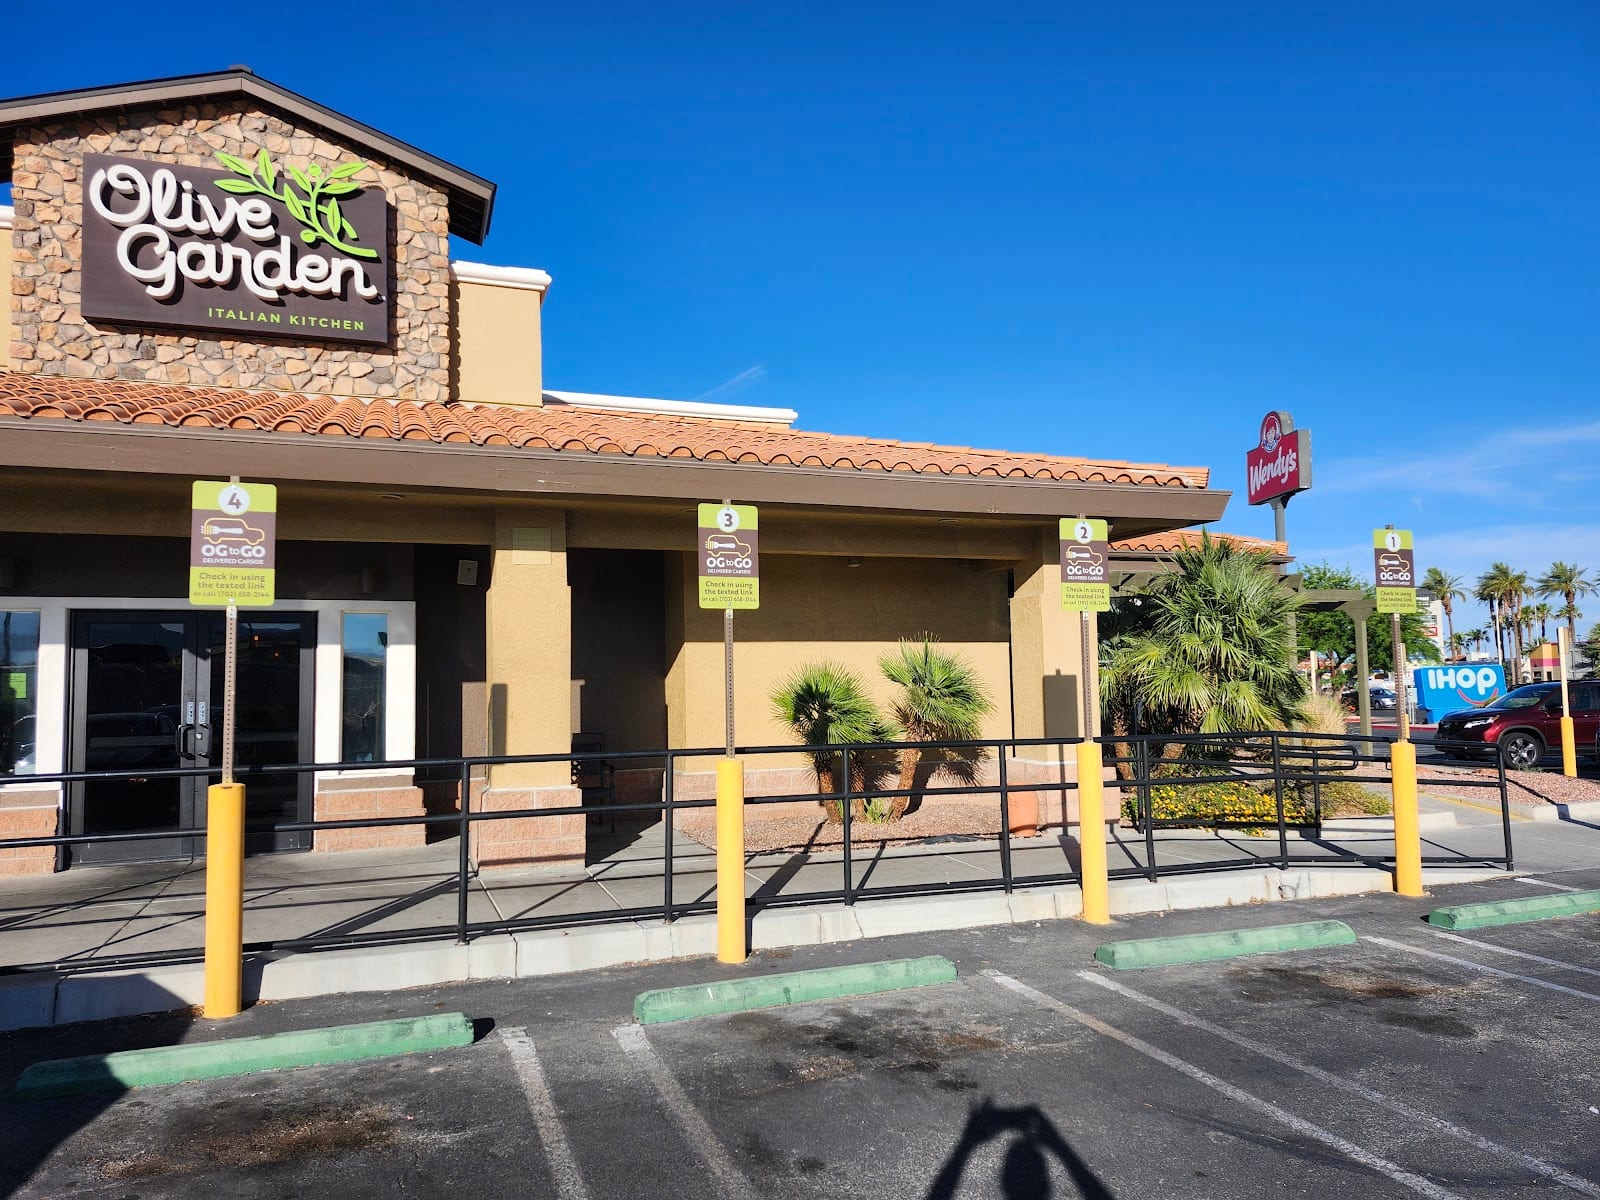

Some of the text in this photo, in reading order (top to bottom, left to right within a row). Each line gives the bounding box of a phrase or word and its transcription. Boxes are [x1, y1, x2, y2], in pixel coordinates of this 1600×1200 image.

[89, 164, 275, 242] Olive
[116, 224, 378, 300] Garden
[208, 308, 365, 331] ITALIAN KITCHEN
[1250, 446, 1296, 496] Wendy's
[226, 492, 242, 510] 4
[724, 513, 733, 528] 3
[1080, 526, 1088, 538] 2
[1392, 536, 1396, 548] 1
[201, 544, 266, 558] OG to GO
[706, 557, 725, 568] OG
[734, 558, 752, 568] GO
[241, 573, 266, 582] using
[1066, 566, 1082, 575] OG
[1089, 566, 1104, 575] GO
[1380, 572, 1392, 580] OG
[1399, 572, 1410, 580] GO
[1428, 667, 1497, 696] IHOP
